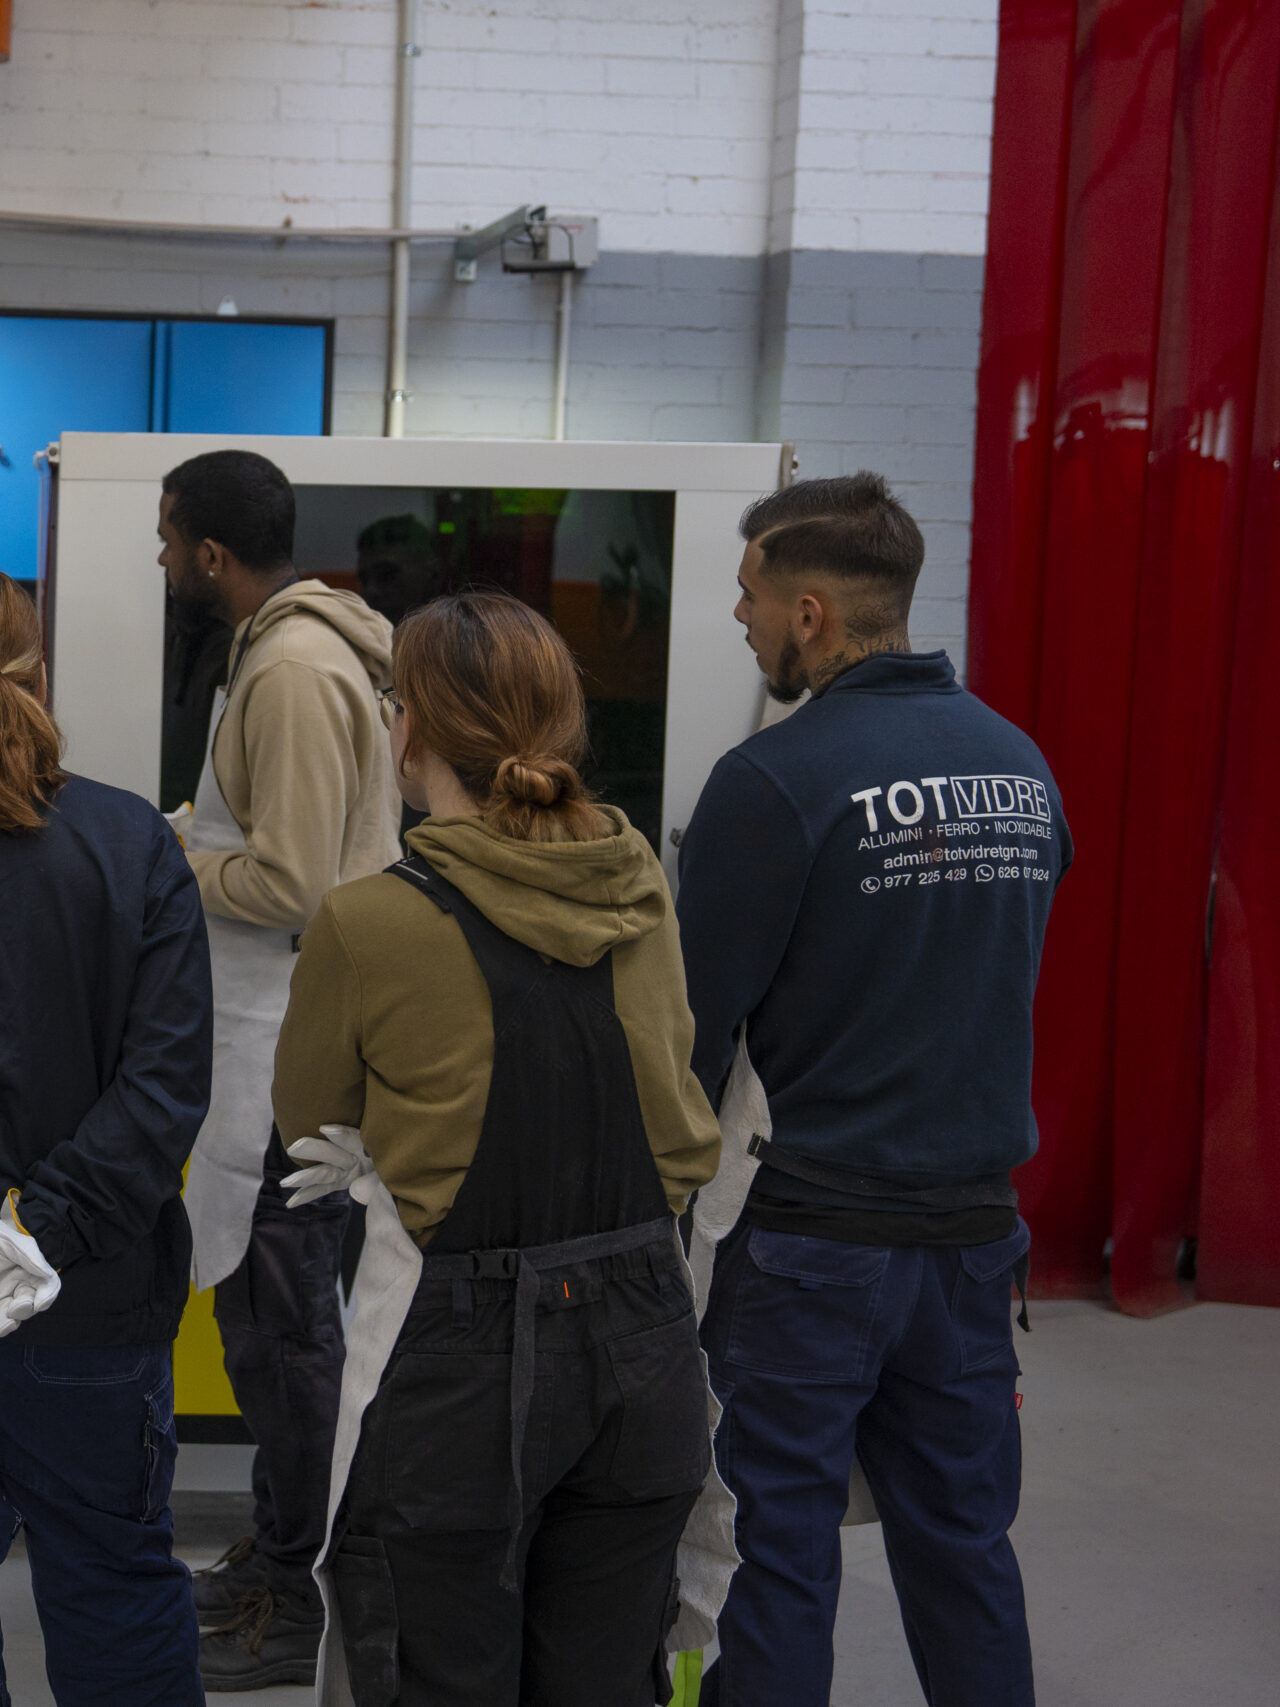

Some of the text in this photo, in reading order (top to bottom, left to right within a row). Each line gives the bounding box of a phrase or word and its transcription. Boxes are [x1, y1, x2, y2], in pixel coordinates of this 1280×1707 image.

[858, 820, 1052, 851] ALUMINI FERRO INOXIDABLE
[884, 873, 912, 888] 977
[918, 870, 941, 885] 225
[945, 868, 967, 881] 429
[998, 866, 1020, 879] 626
[1032, 868, 1049, 882] 924
